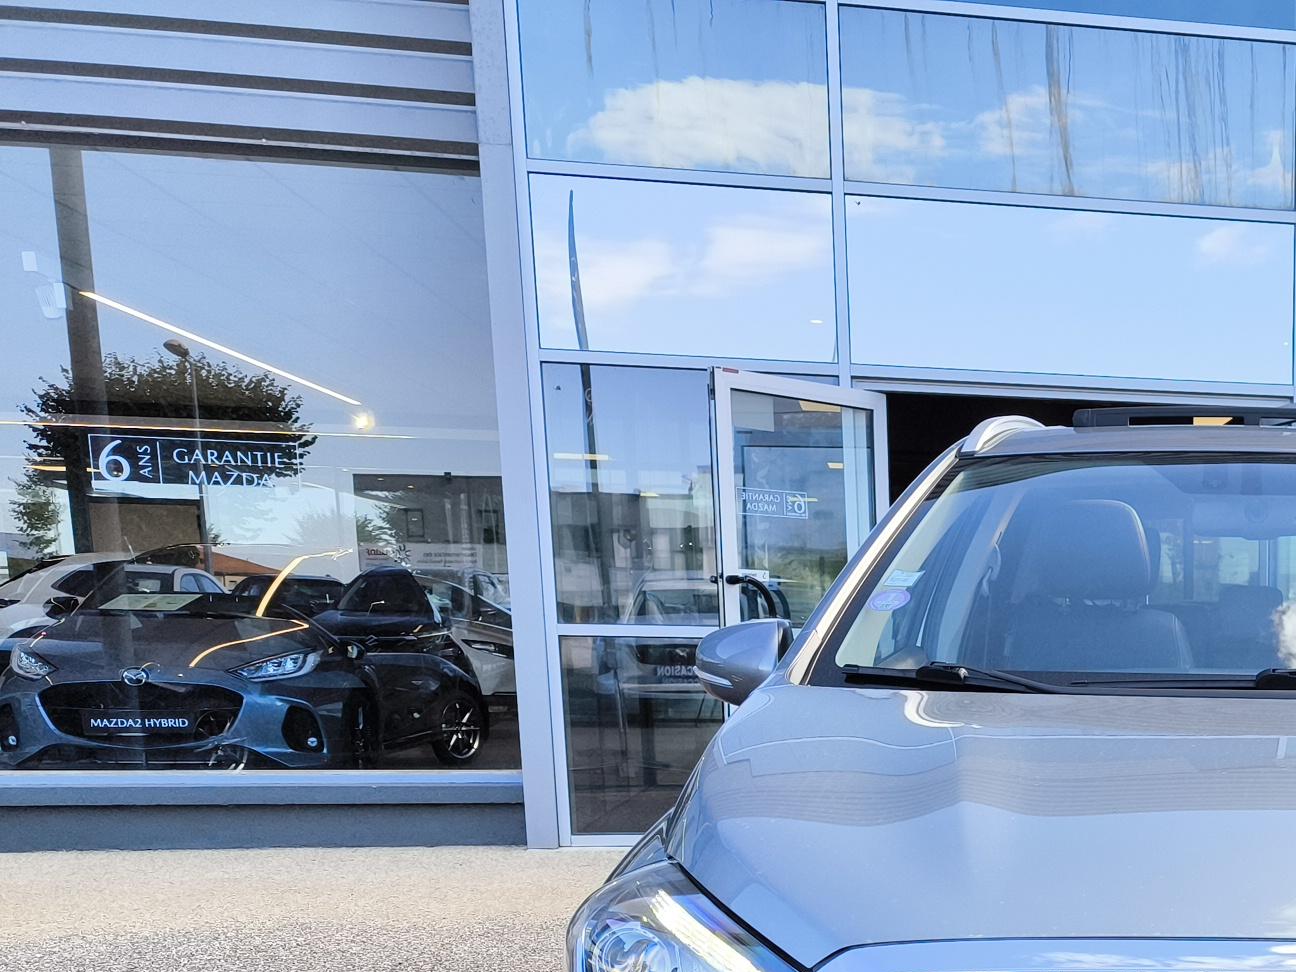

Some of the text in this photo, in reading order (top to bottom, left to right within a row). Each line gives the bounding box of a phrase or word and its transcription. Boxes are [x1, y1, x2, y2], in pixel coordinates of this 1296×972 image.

[99, 440, 153, 482] 6 ANS
[172, 448, 284, 468] GARANTIE
[188, 470, 275, 488] MAZDA
[90, 718, 189, 728] MAZDA2 HYBRID
